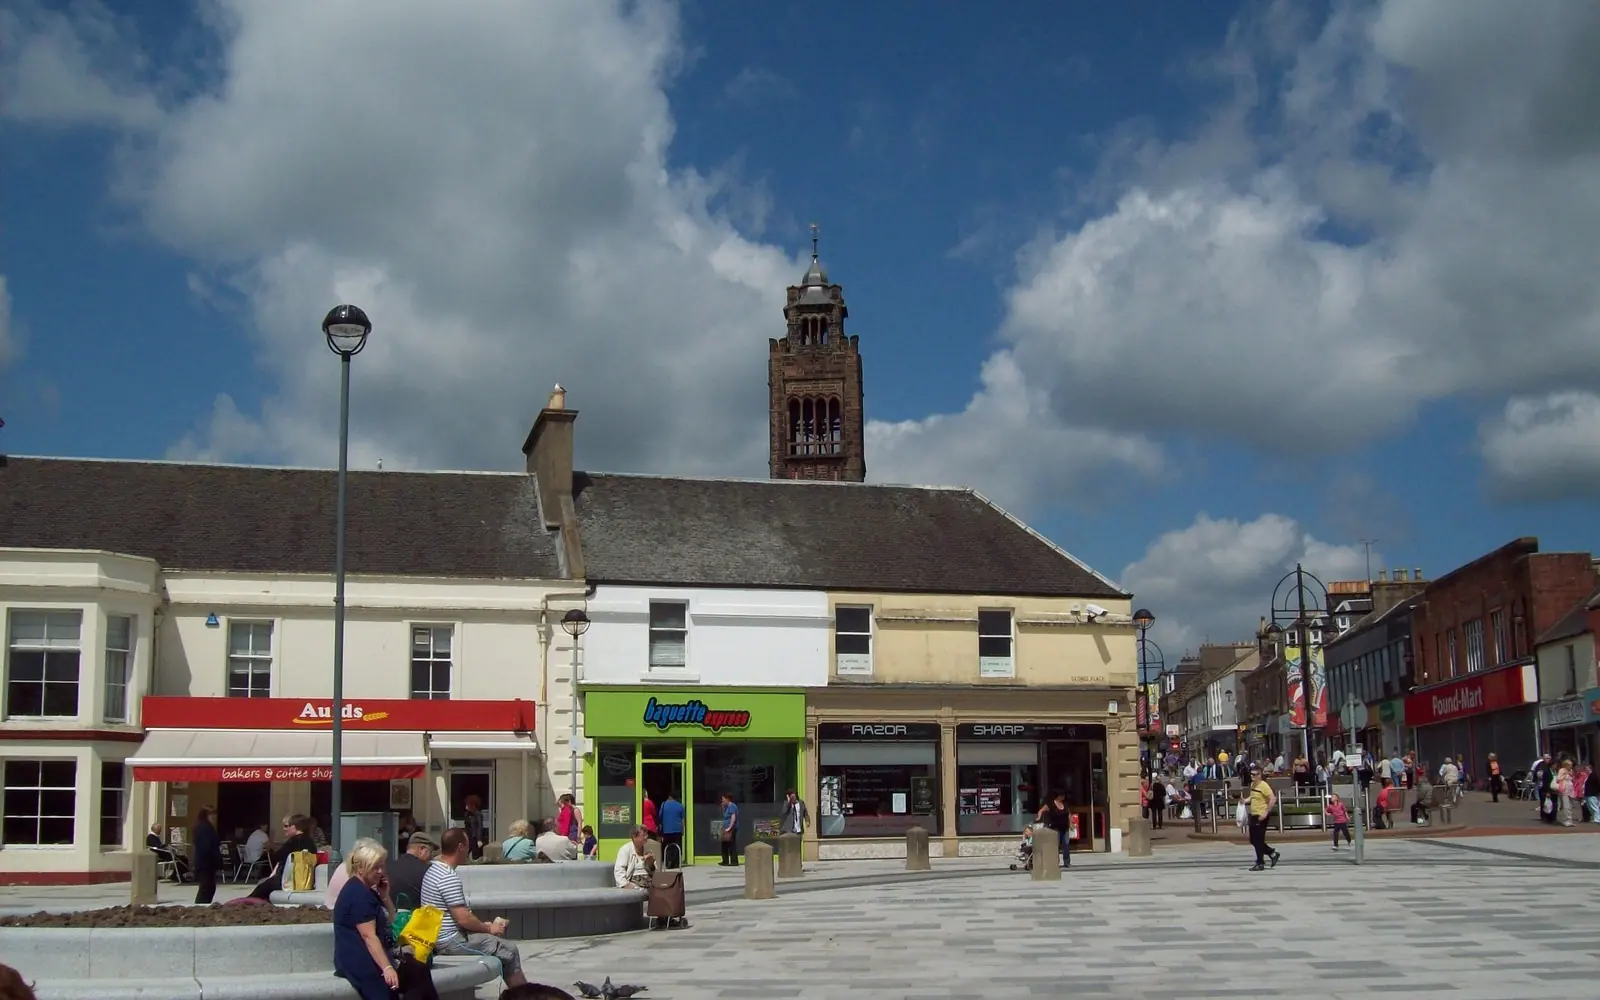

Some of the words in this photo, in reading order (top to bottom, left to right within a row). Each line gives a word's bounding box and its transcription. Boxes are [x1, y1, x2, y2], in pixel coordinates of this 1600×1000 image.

[1432, 685, 1483, 717] Pound-Mart
[300, 702, 363, 719] Auds
[644, 697, 707, 727] baguette
[703, 710, 749, 730] express
[851, 725, 907, 735] RAZOR
[973, 725, 1025, 735] SHARP
[222, 768, 260, 779] bakers
[276, 767, 308, 779] coffee
